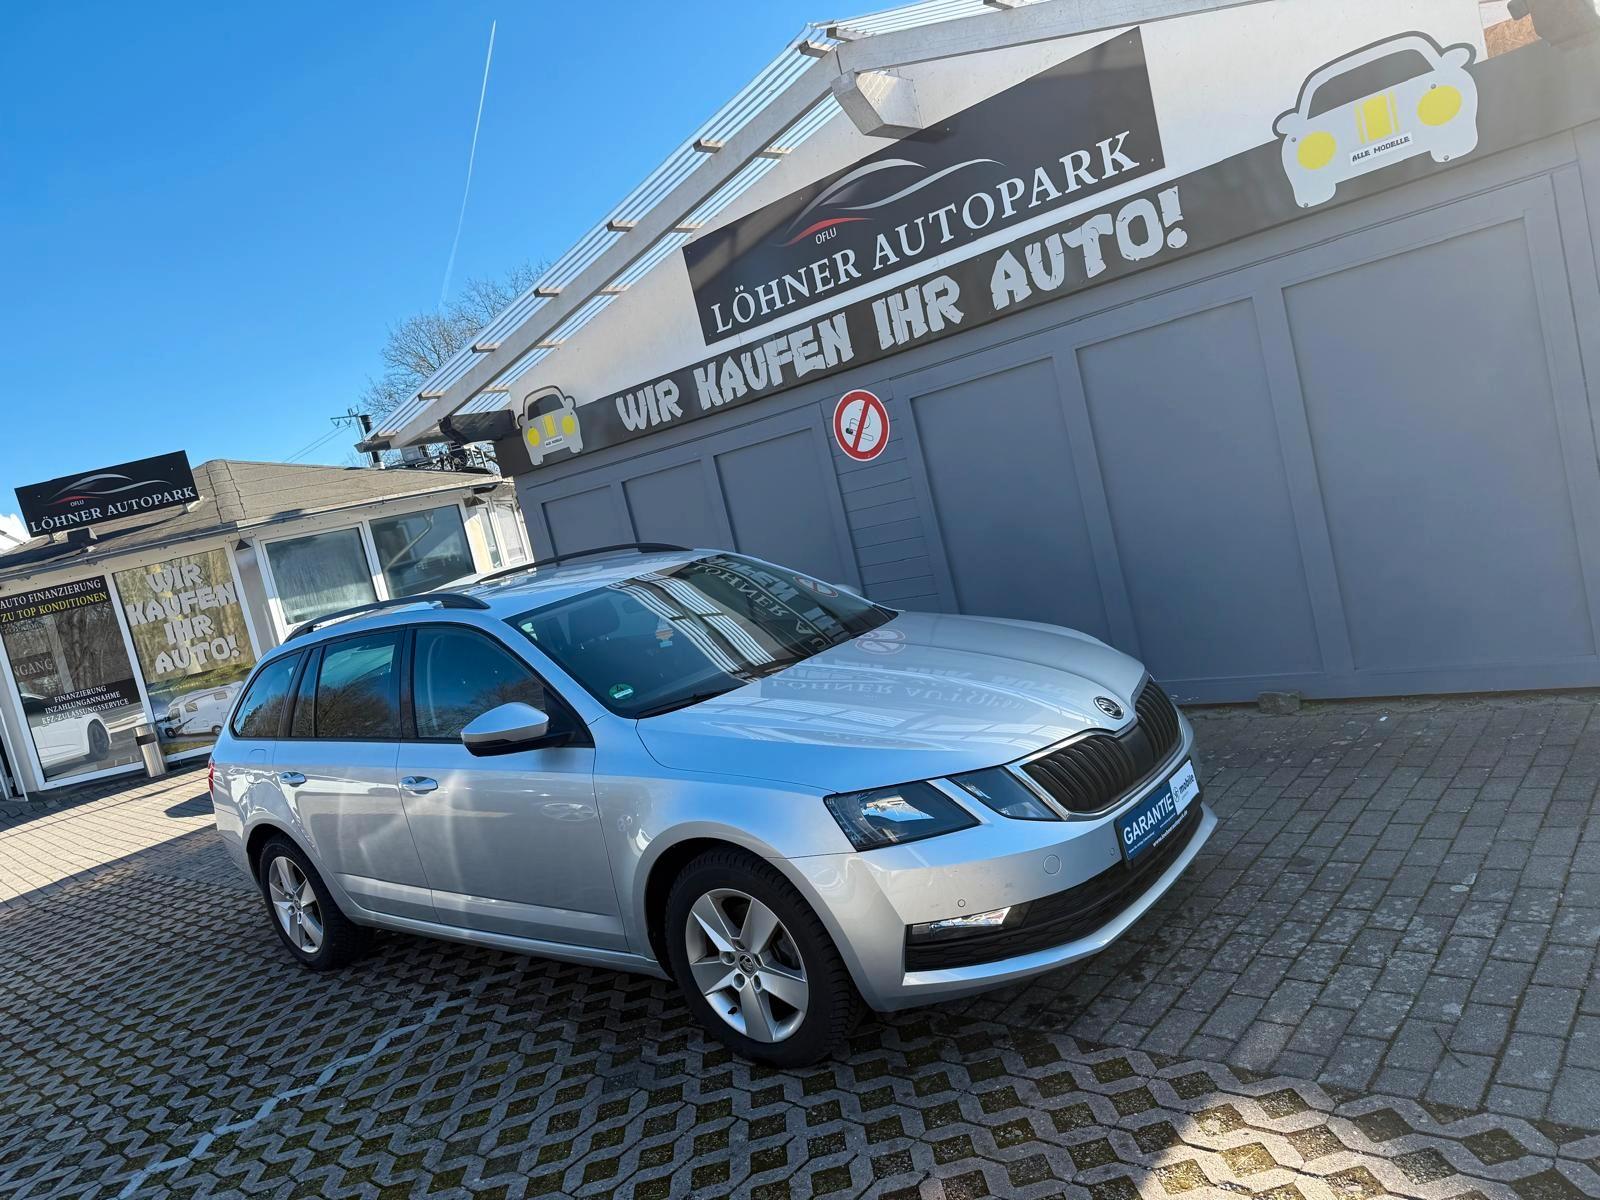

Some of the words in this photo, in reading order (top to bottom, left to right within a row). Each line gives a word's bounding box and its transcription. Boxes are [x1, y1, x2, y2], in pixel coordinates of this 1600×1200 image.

[1352, 149, 1371, 162] ALLE
[1373, 136, 1410, 154] MODELLE
[710, 249, 862, 334] LÖHNER
[872, 130, 1140, 270] AUTOPARK
[815, 226, 837, 245] OFLU
[615, 378, 684, 432] WIR
[693, 312, 855, 411] KAUFEN
[871, 275, 964, 350] IHR
[990, 186, 1188, 311] AUTO!
[30, 507, 103, 533] LÖHNER
[107, 486, 196, 516] AUTOPARK
[145, 564, 204, 593] WIR
[0, 595, 26, 610] AUTO
[28, 580, 101, 603] FINANZIERUNG
[1, 611, 15, 623] ZU
[17, 607, 36, 619] TOP
[38, 592, 107, 615] KONDITIONEN
[125, 581, 239, 626] KAUFEN
[163, 614, 215, 646] IHR
[155, 634, 240, 674] AUTO!
[54, 685, 107, 703] FINANZIERUNG
[1123, 792, 1174, 845] GARANTIE
